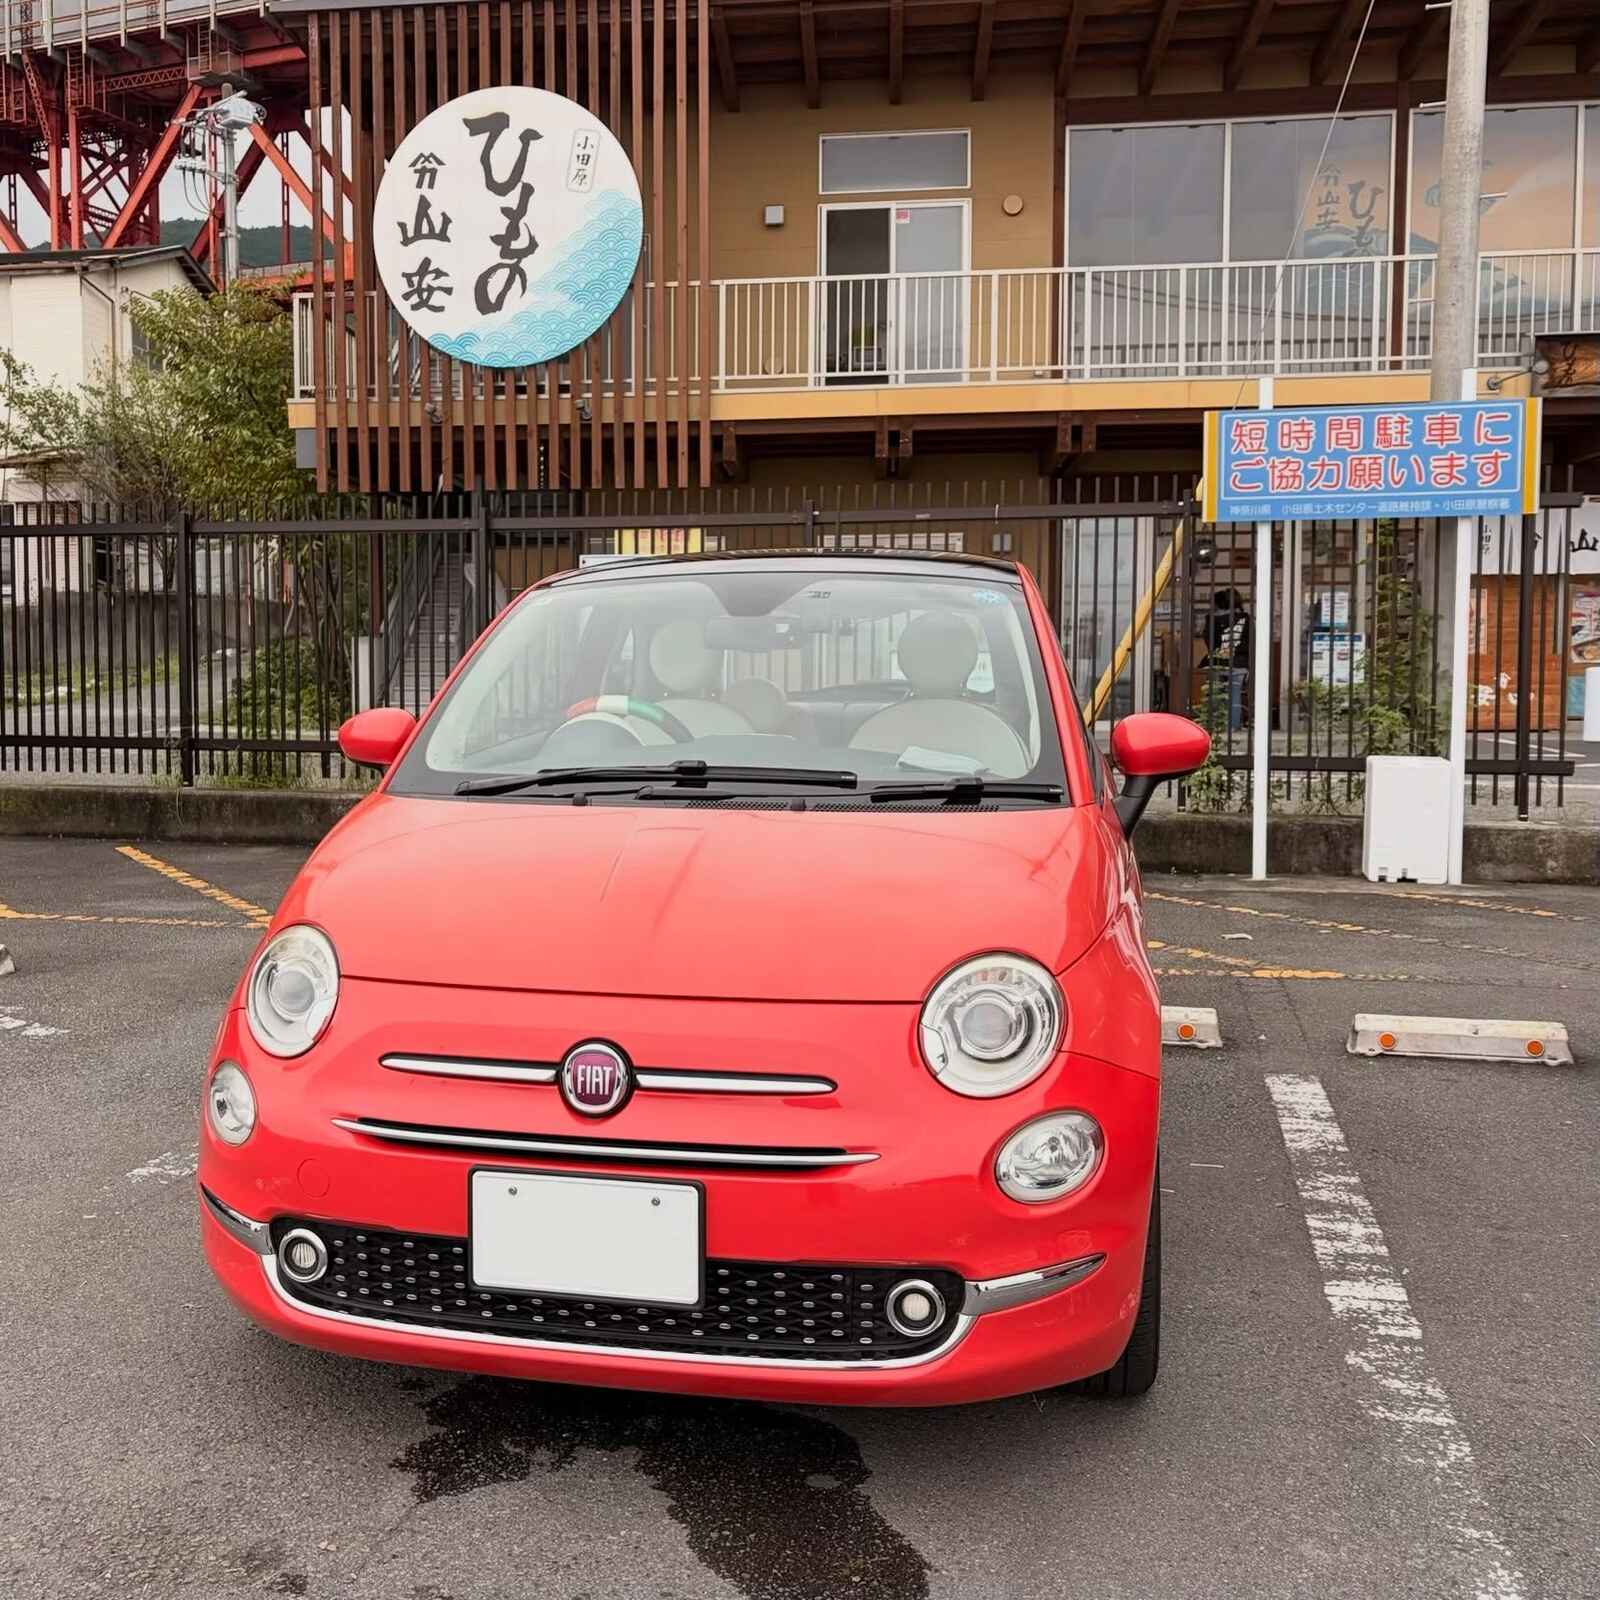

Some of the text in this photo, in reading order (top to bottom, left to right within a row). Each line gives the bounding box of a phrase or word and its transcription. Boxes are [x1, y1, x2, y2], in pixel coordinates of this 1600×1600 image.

[571, 135, 595, 186] 小田原
[461, 111, 544, 315] ひもの
[1231, 410, 1512, 454] 短時間駐車に
[1230, 450, 1511, 492] ご協力願います
[577, 1064, 613, 1096] FIAT
